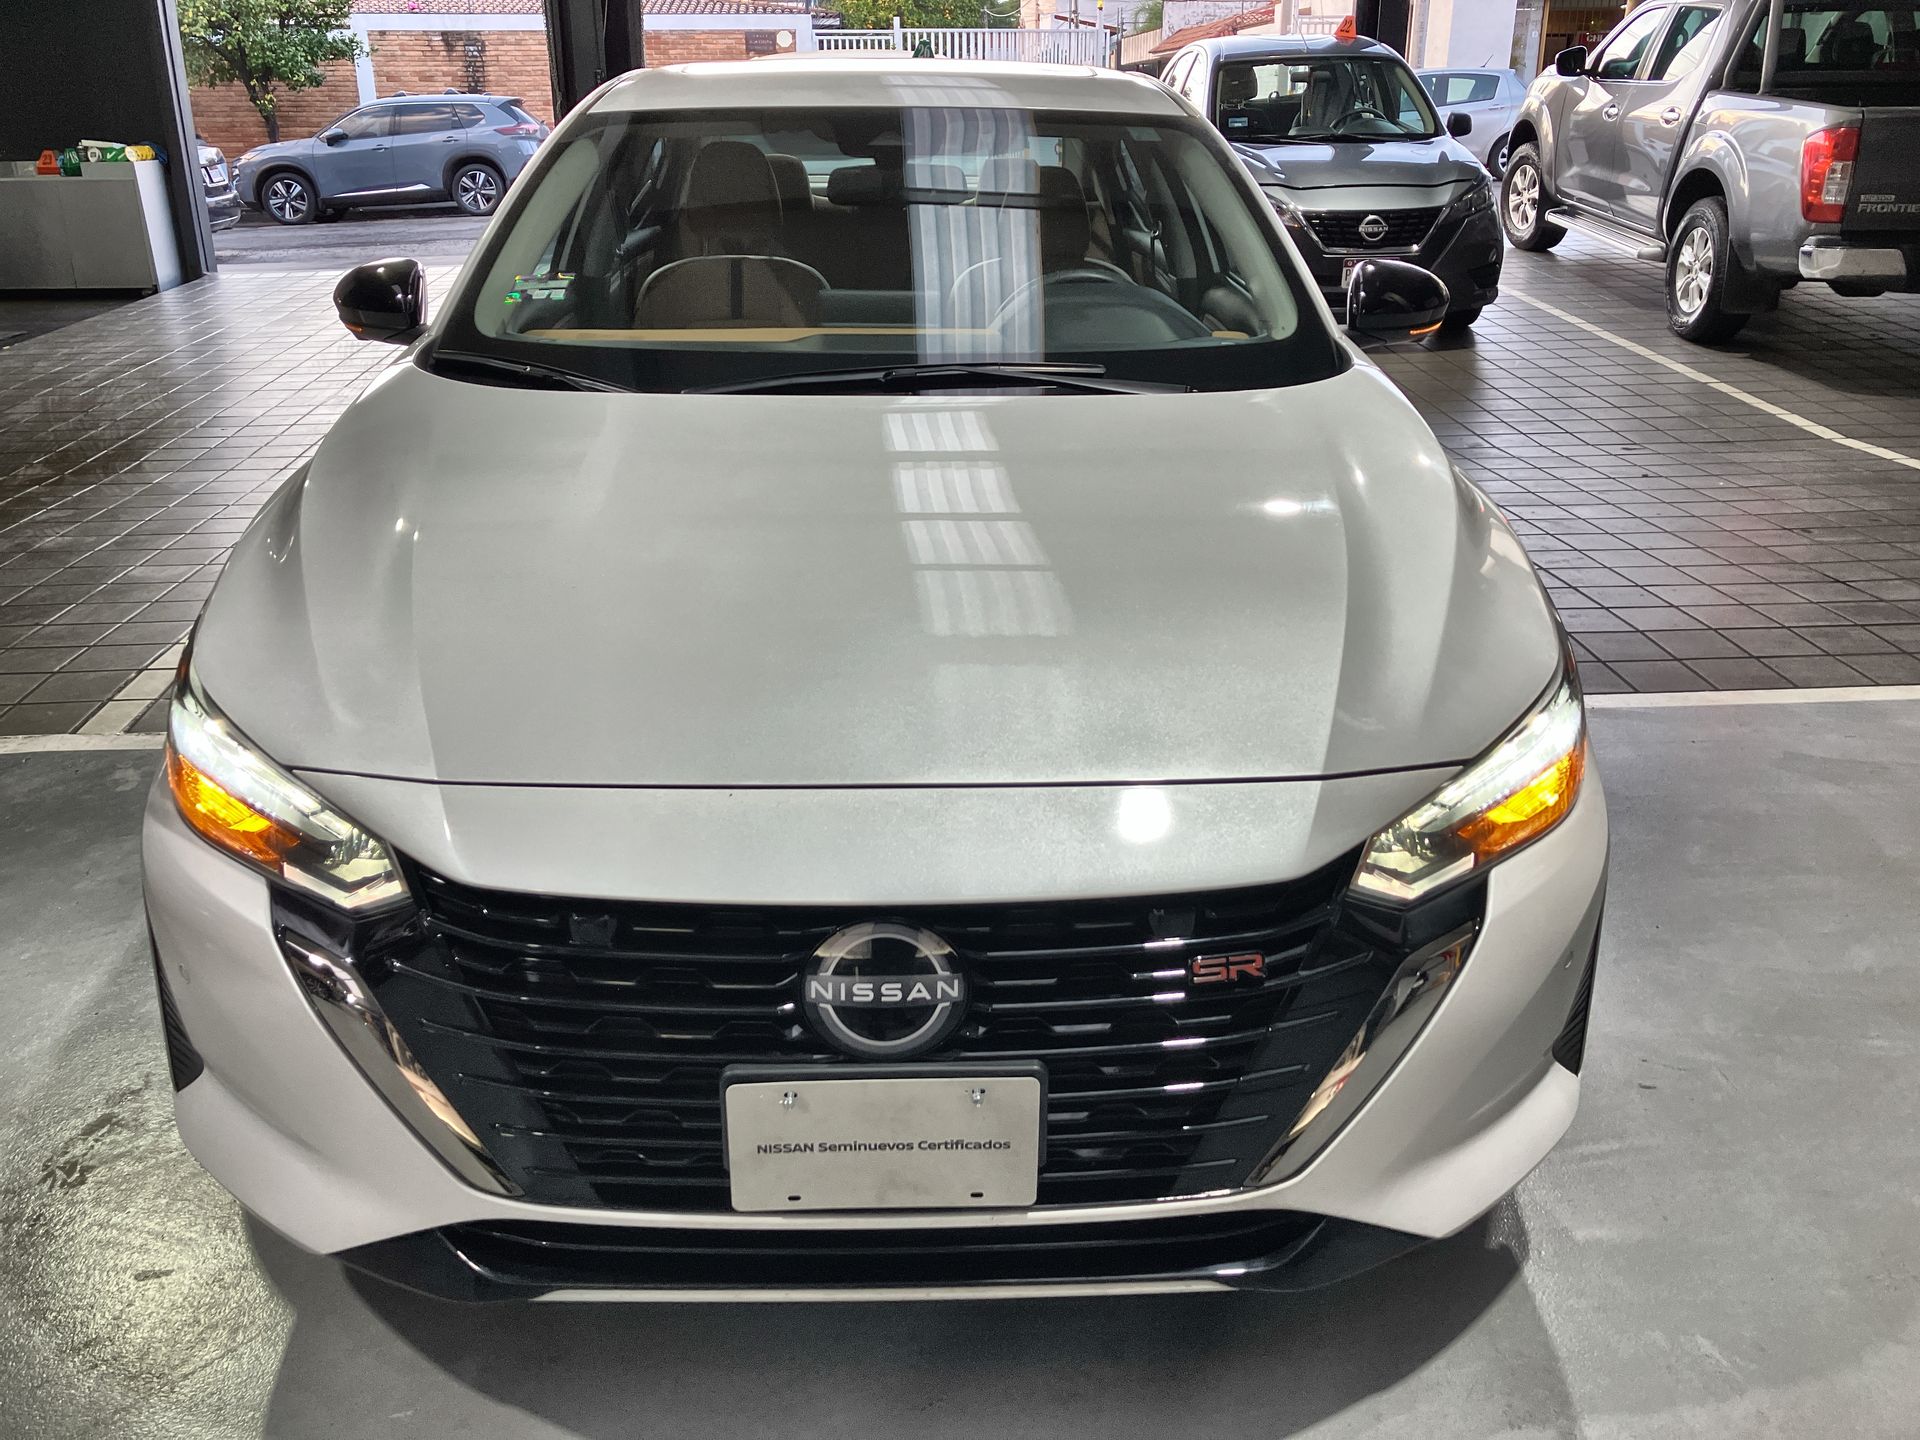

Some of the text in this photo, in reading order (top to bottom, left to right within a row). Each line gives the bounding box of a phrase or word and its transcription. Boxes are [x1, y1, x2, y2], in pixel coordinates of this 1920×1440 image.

[1192, 954, 1265, 984] SR
[810, 979, 959, 1002] NISSAN
[757, 1139, 1011, 1154] NISSAN Seminuevos Certificados
